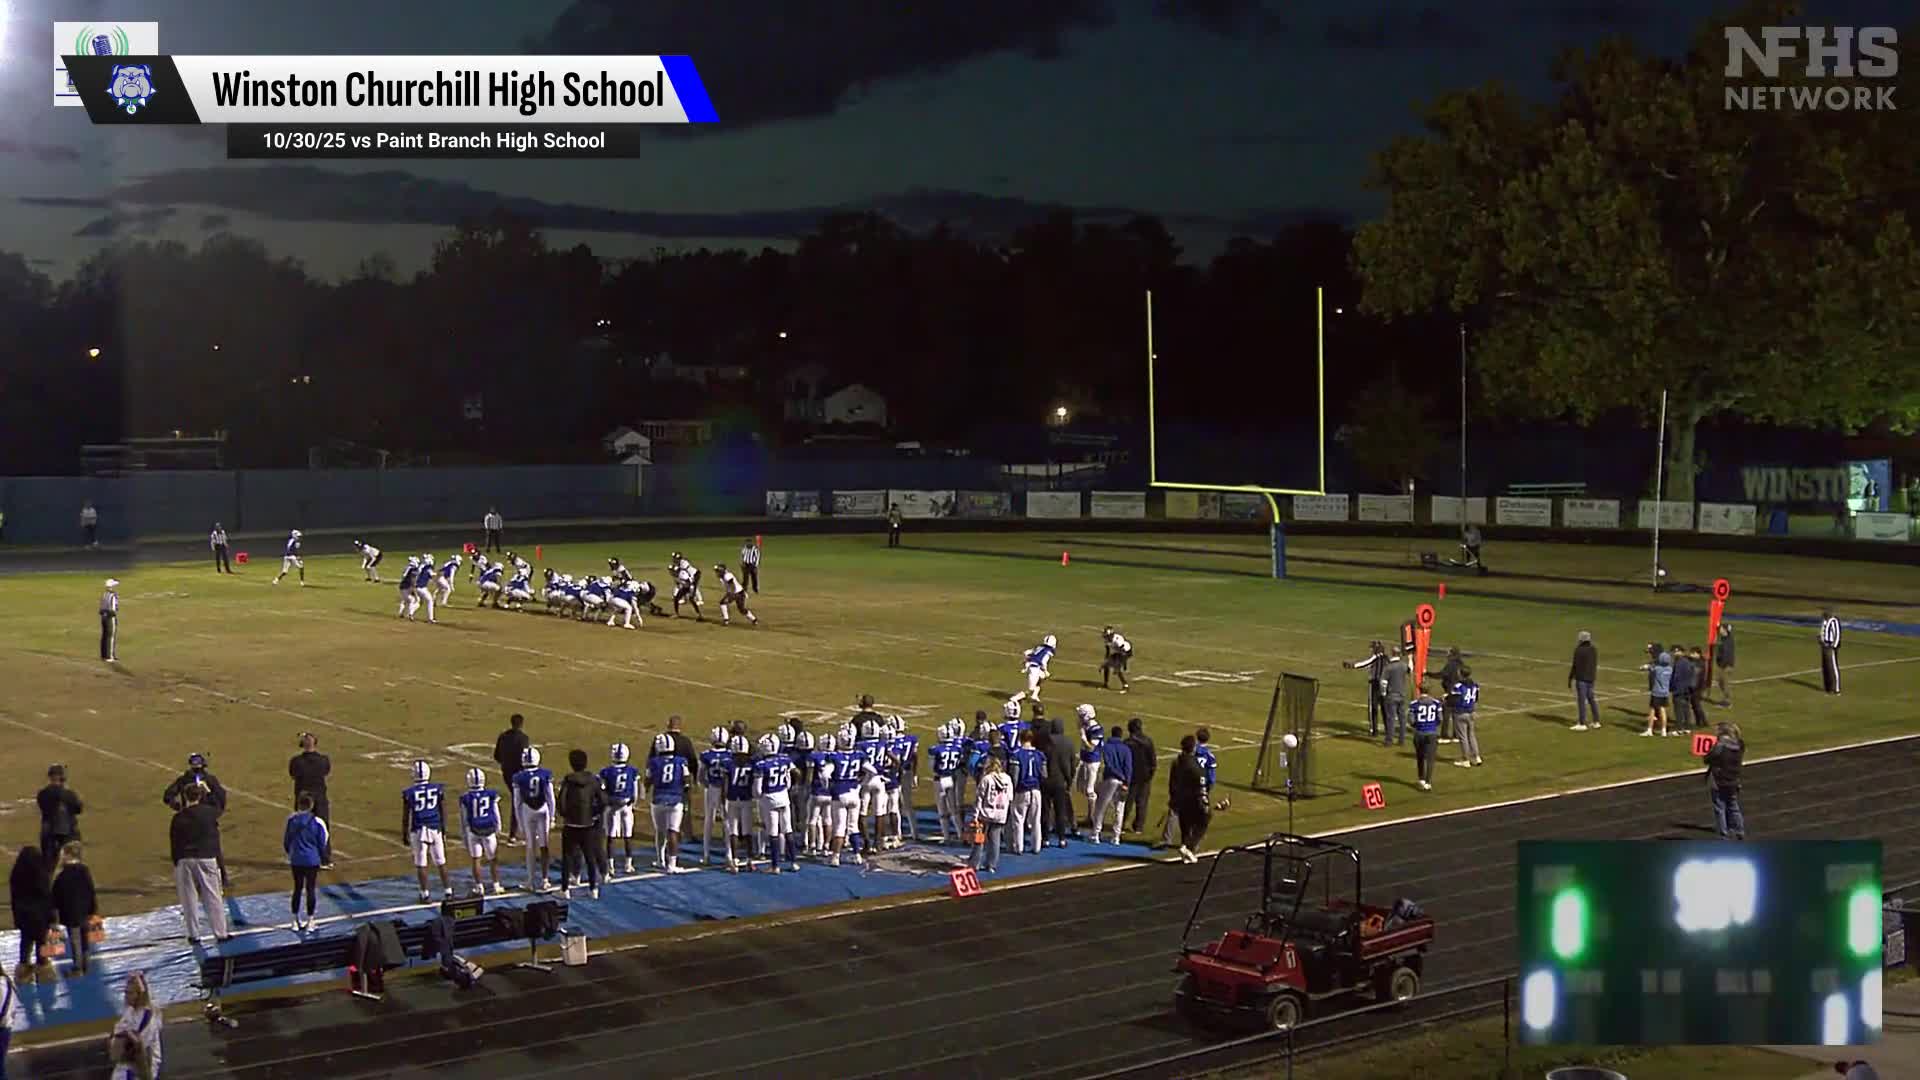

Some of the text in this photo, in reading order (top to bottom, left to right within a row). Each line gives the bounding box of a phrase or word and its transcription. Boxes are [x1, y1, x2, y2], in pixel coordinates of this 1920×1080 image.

[1464, 688, 1478, 704] 44
[1418, 705, 1436, 722] 26
[1009, 729, 1019, 748] 7
[1696, 737, 1713, 753] 10
[866, 747, 885, 766] 34
[939, 752, 960, 770] 35
[662, 763, 674, 783] 8
[733, 768, 751, 787] 15
[768, 767, 787, 787] 52
[840, 760, 861, 779] 72
[529, 776, 540, 797] 9
[414, 788, 437, 811] 55
[1366, 787, 1383, 806] 20
[472, 796, 490, 818] 12
[955, 871, 978, 893] 30
